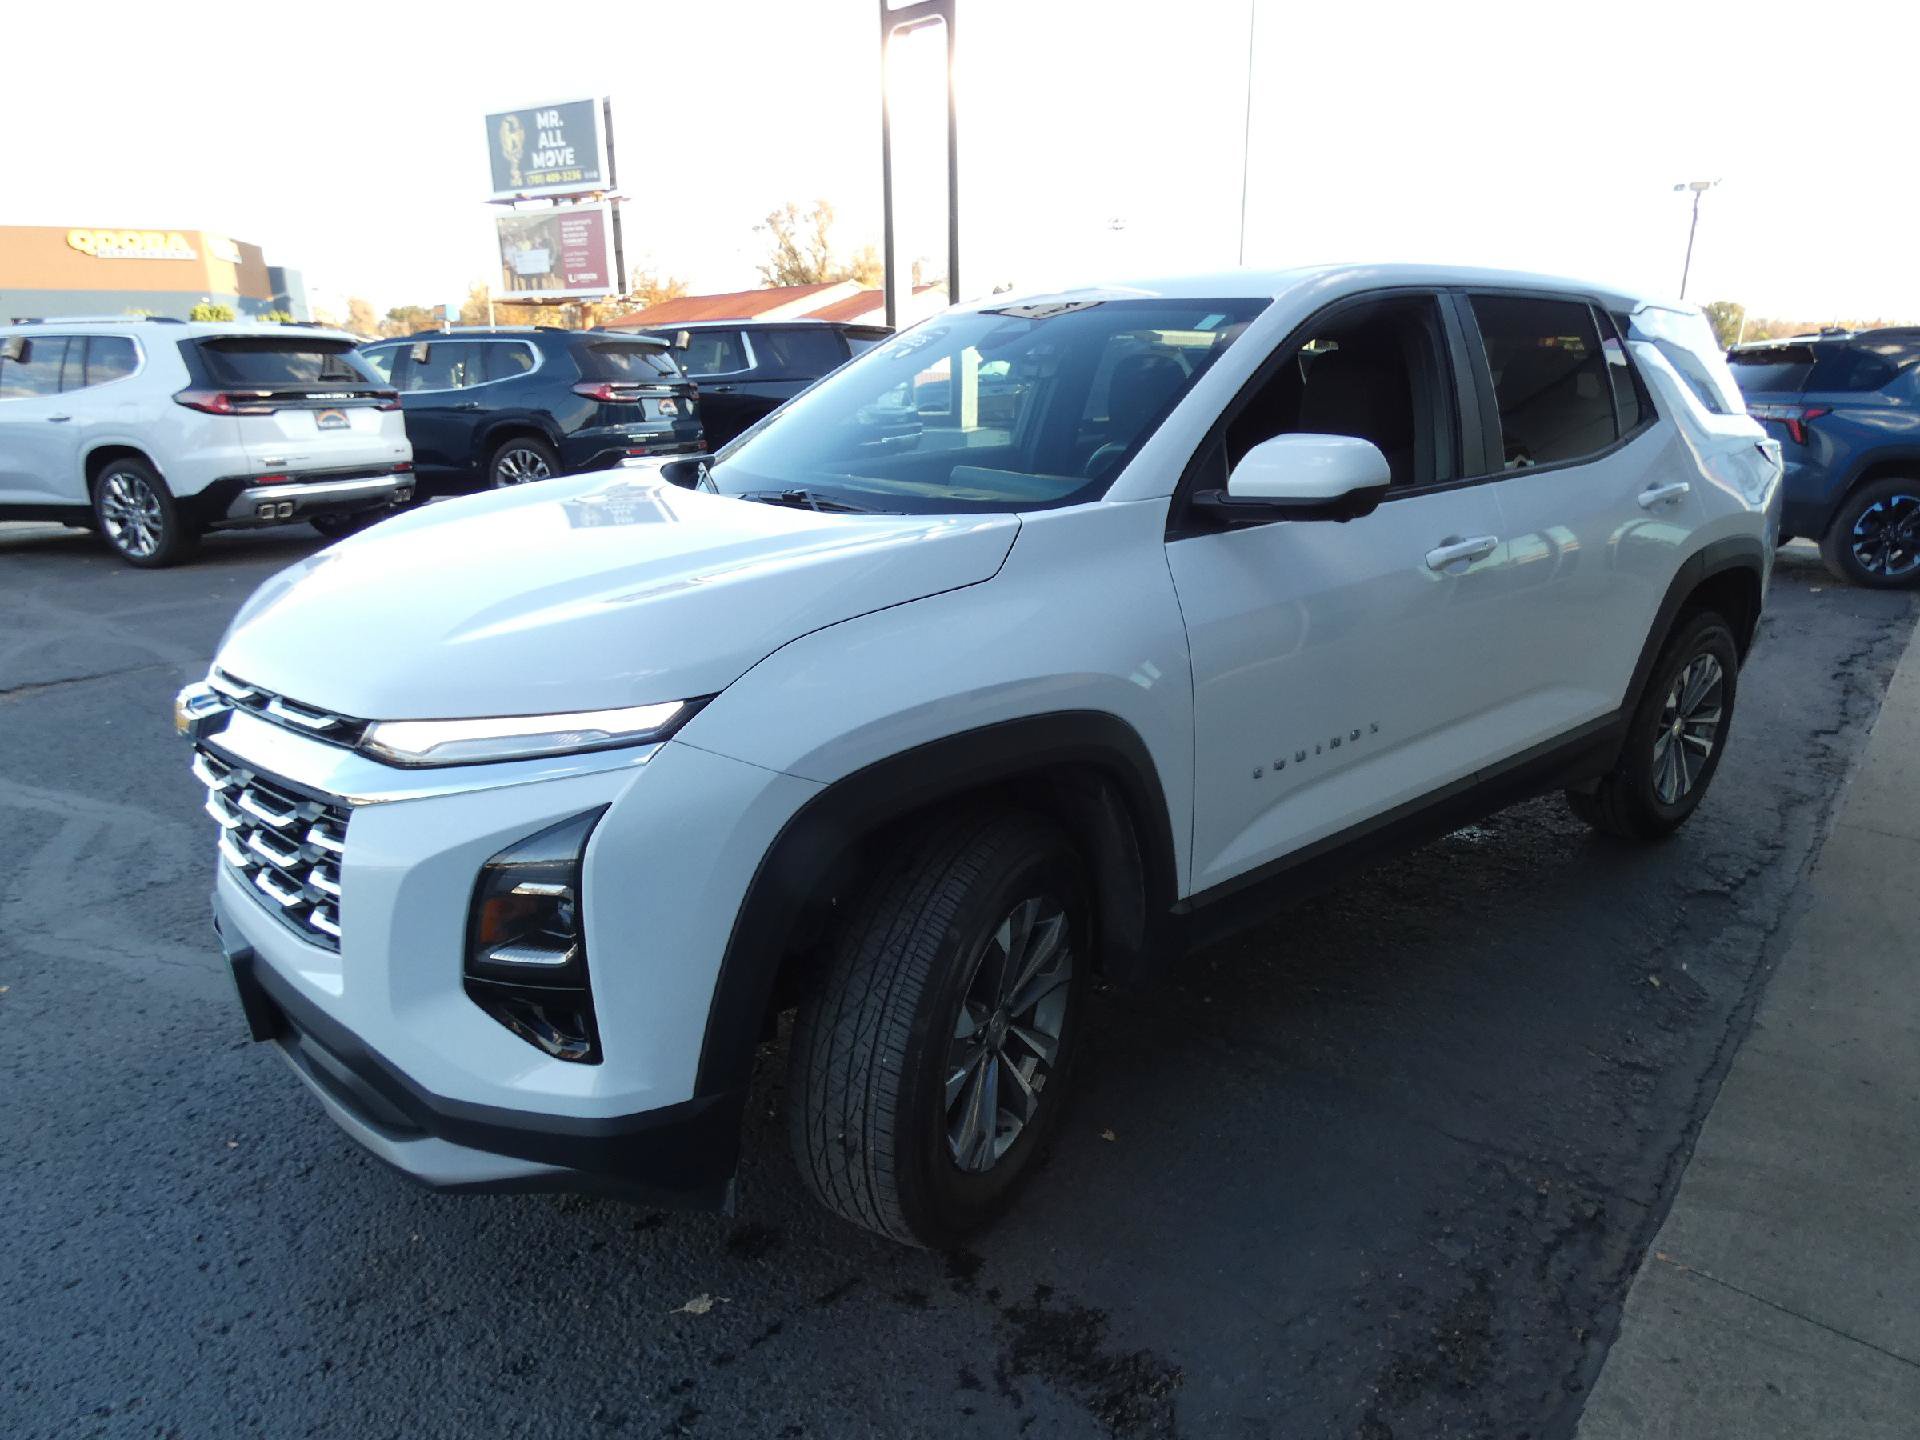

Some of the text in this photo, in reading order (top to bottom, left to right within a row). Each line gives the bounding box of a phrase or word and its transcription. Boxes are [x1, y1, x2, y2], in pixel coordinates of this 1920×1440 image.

[536, 109, 564, 129] MR.
[538, 129, 566, 149] ALL
[532, 147, 575, 168] MOVE
[1252, 721, 1379, 780] EQUINOX
